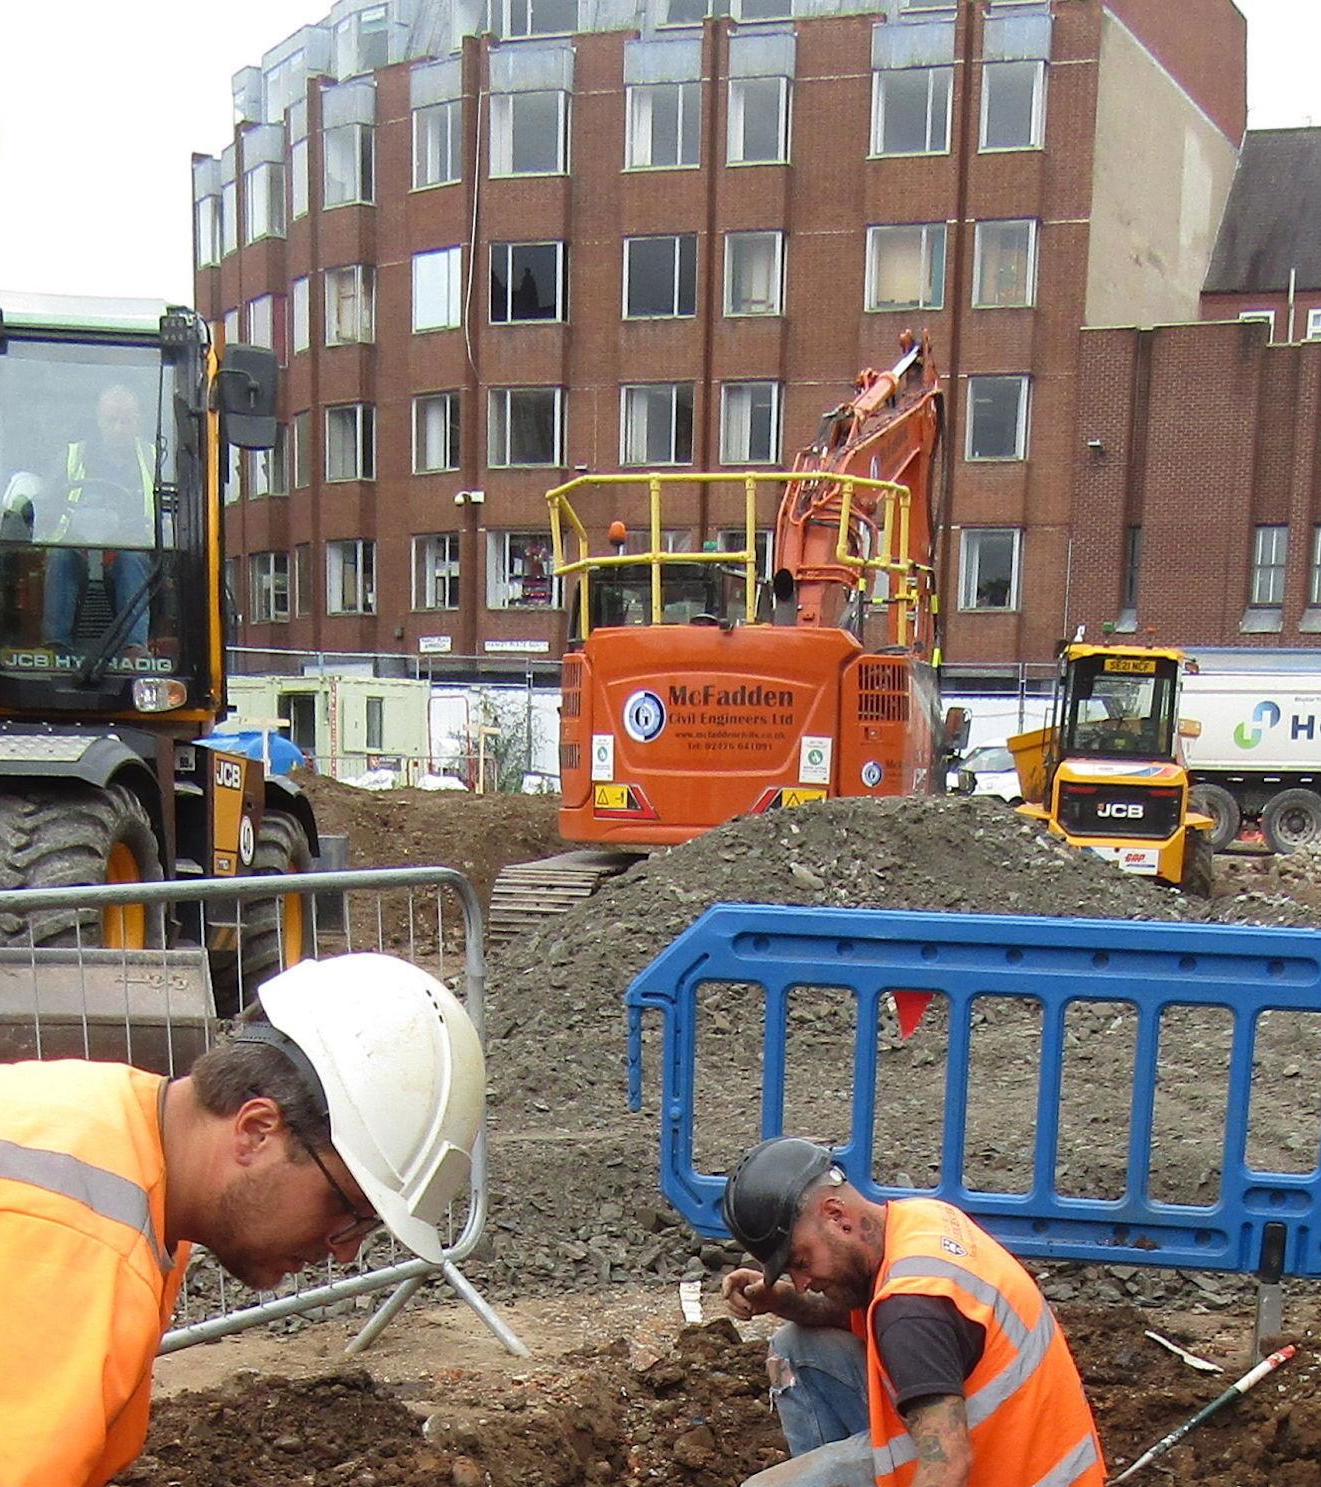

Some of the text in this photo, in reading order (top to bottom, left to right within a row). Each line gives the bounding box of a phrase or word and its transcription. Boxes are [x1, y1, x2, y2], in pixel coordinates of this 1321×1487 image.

[5, 653, 50, 668] JCB
[668, 685, 794, 708] McFadden
[668, 714, 794, 727] Civil Engineers Ltd
[216, 760, 242, 790] JCB
[1097, 802, 1144, 819] JCB
